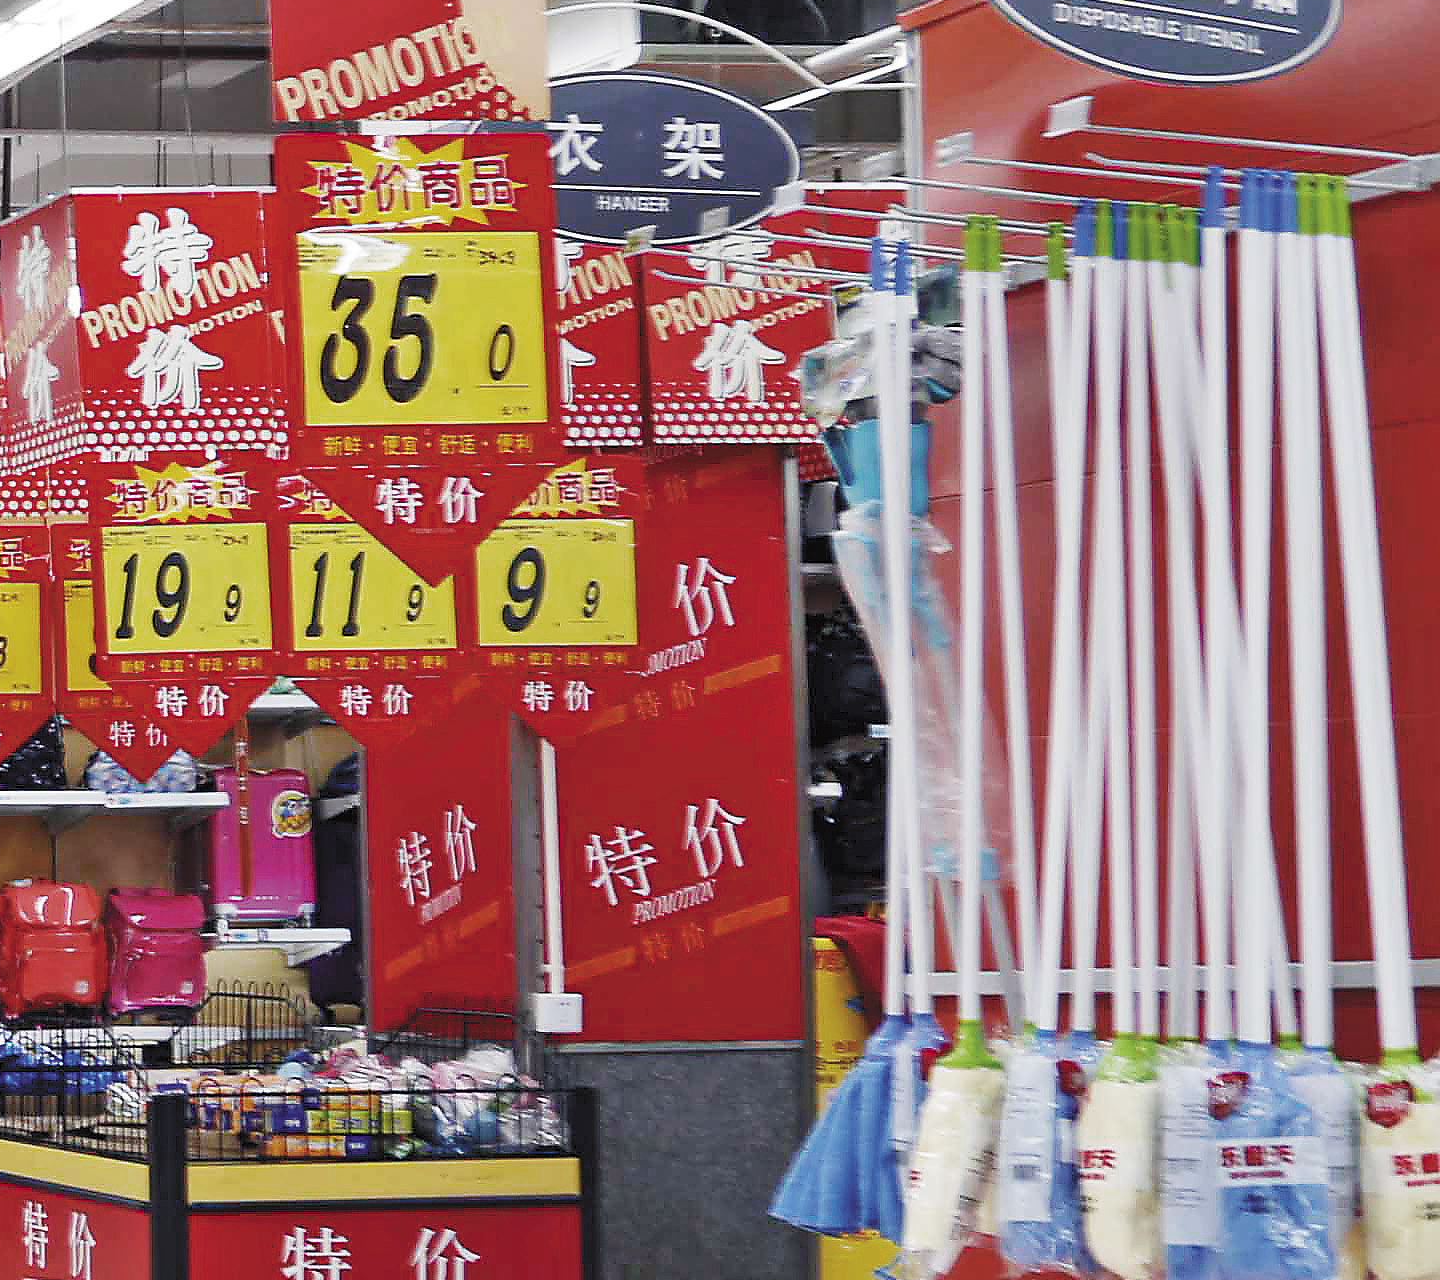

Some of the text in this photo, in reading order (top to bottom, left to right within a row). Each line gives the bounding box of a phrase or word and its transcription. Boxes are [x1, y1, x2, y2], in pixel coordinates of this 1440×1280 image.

[1053, 2, 1181, 43] DISPOSABLE
[549, 114, 726, 181] 衣架
[314, 154, 517, 216] 特价商品
[595, 193, 672, 213] HANGER
[122, 207, 224, 411] 特价
[319, 273, 515, 406] 35 0
[112, 473, 255, 513] 特价商品
[376, 475, 485, 526] 特价
[114, 550, 242, 640] 19 9
[304, 551, 424, 639] 11 9
[501, 546, 602, 633] 9 9
[155, 685, 230, 719] 特价
[339, 683, 414, 717] 特价
[521, 680, 596, 712] 特价
[396, 805, 478, 906] 特价
[584, 797, 747, 907] 特价
